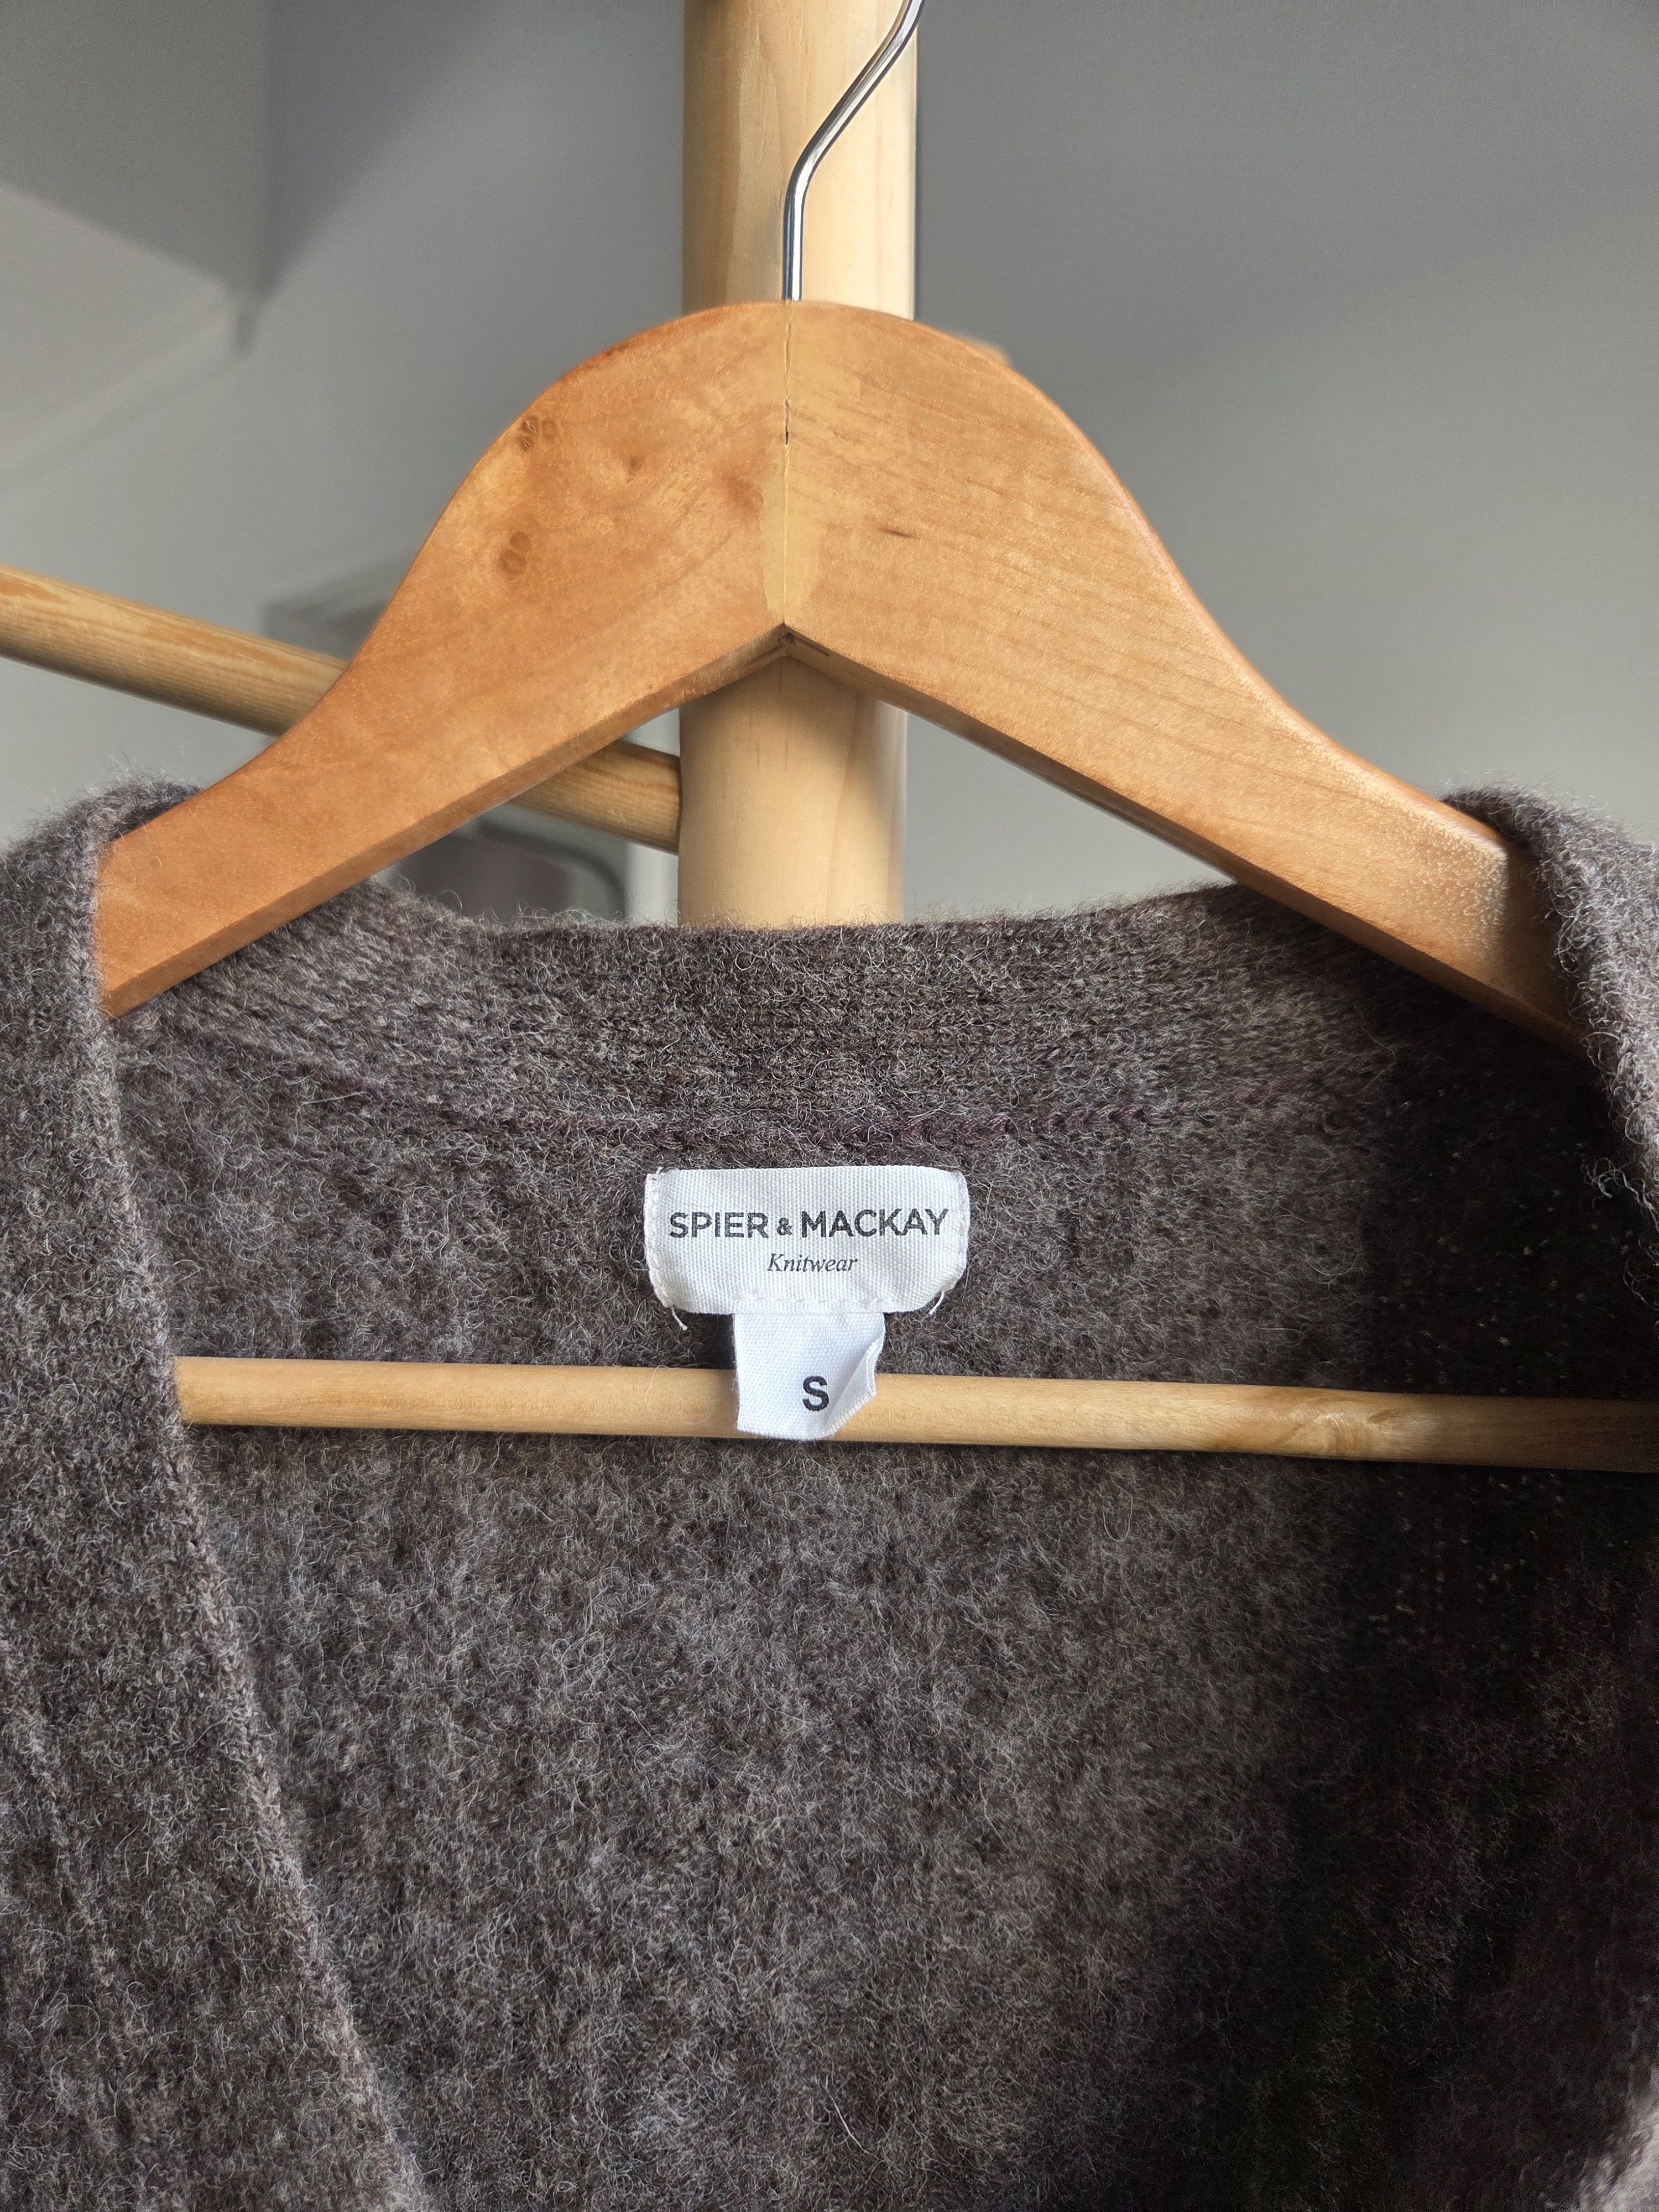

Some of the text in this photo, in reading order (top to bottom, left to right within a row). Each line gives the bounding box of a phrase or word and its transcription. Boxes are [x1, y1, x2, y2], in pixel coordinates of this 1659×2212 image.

[669, 1208, 949, 1239] SPIER & MACKAY
[767, 1253, 859, 1272] Knitwear
[802, 1375, 830, 1412] S
